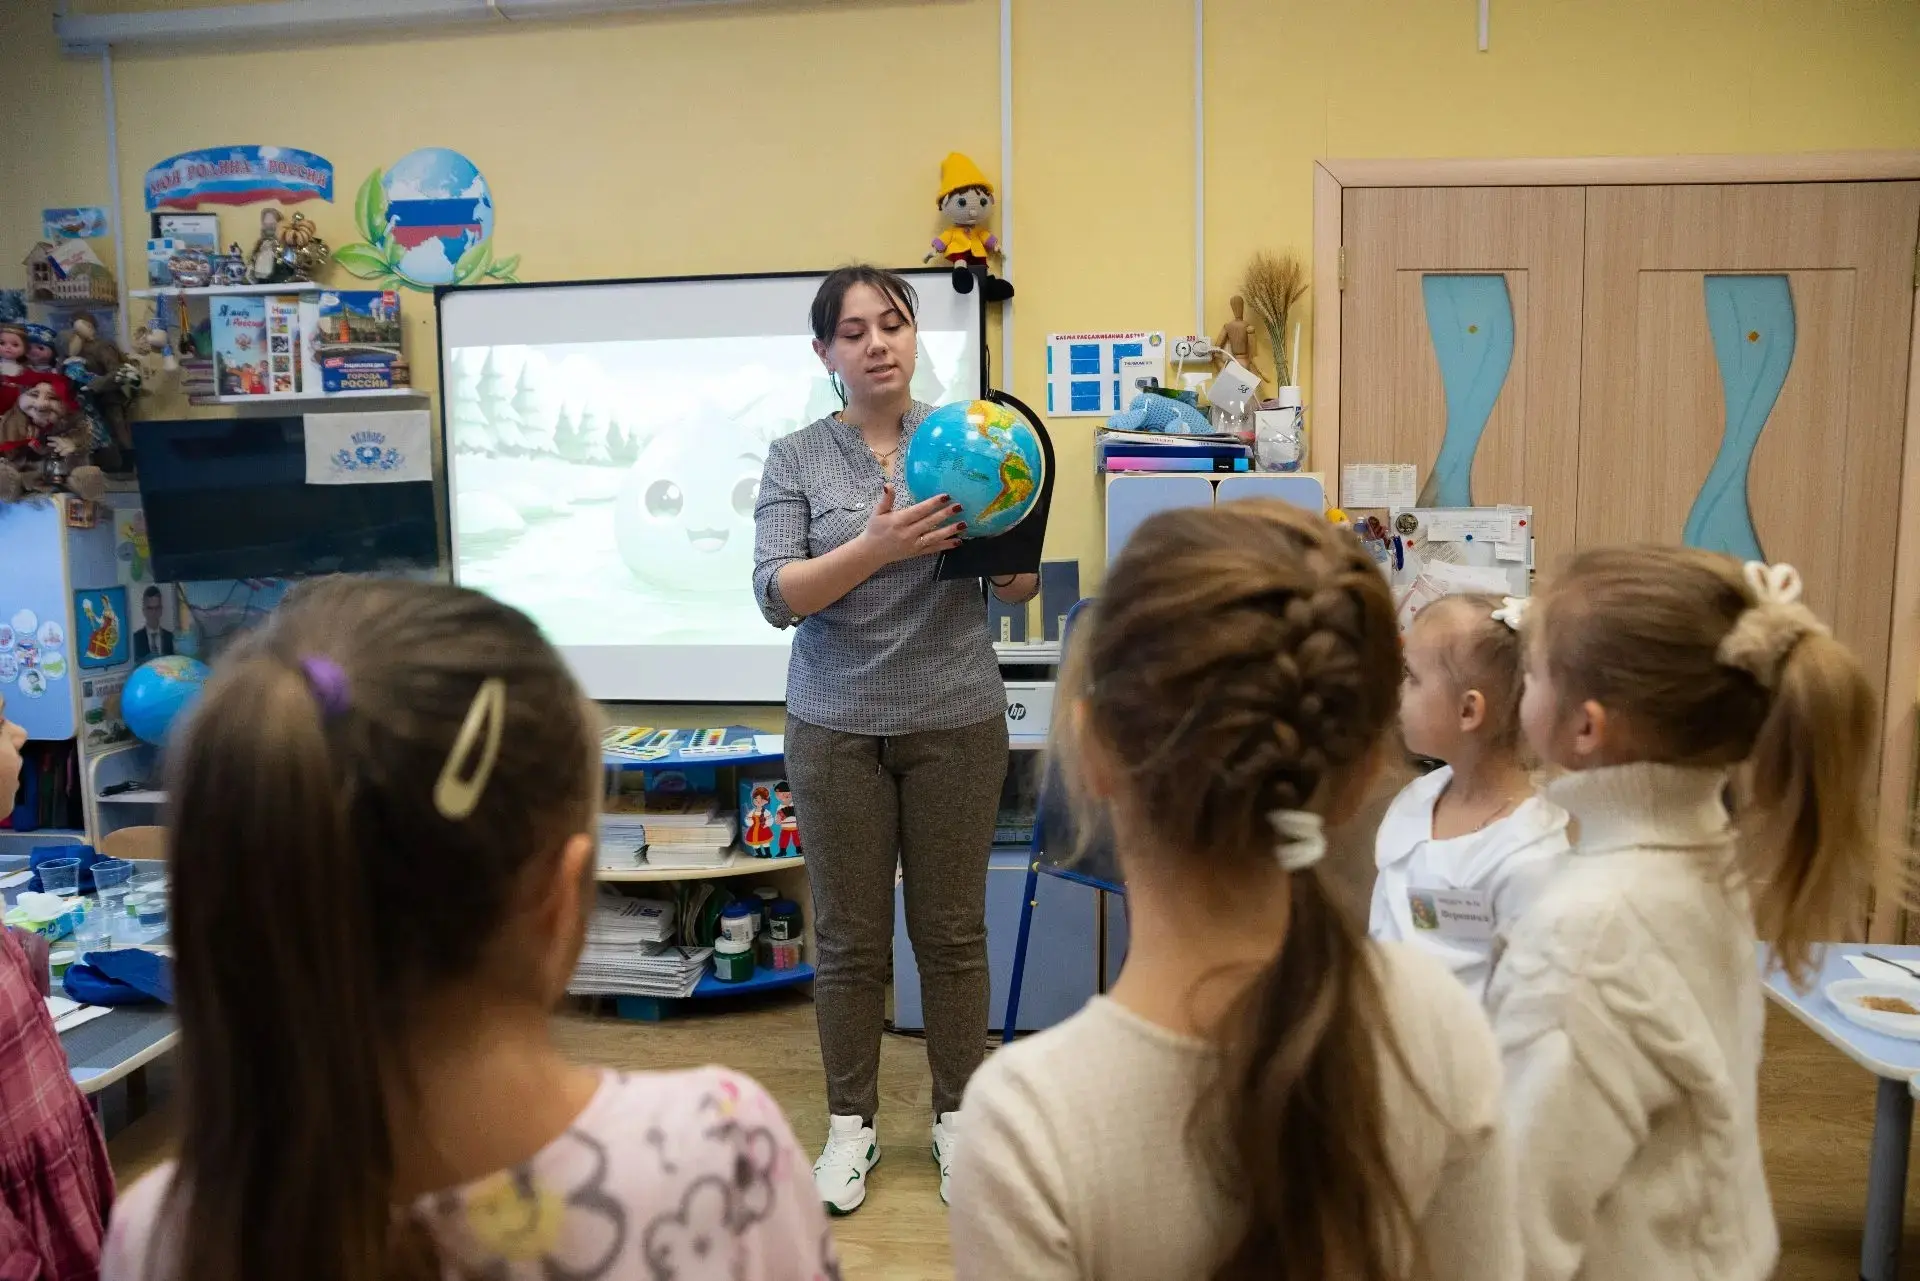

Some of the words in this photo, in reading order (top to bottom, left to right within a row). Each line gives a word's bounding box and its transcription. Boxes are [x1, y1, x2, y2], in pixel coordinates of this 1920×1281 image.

[151, 170, 181, 194] МОЯ
[187, 160, 251, 180] РОДИНА
[268, 160, 326, 188] РОССИЯ
[340, 380, 388, 388] РОССИИ
[1009, 703, 1025, 720] hp
